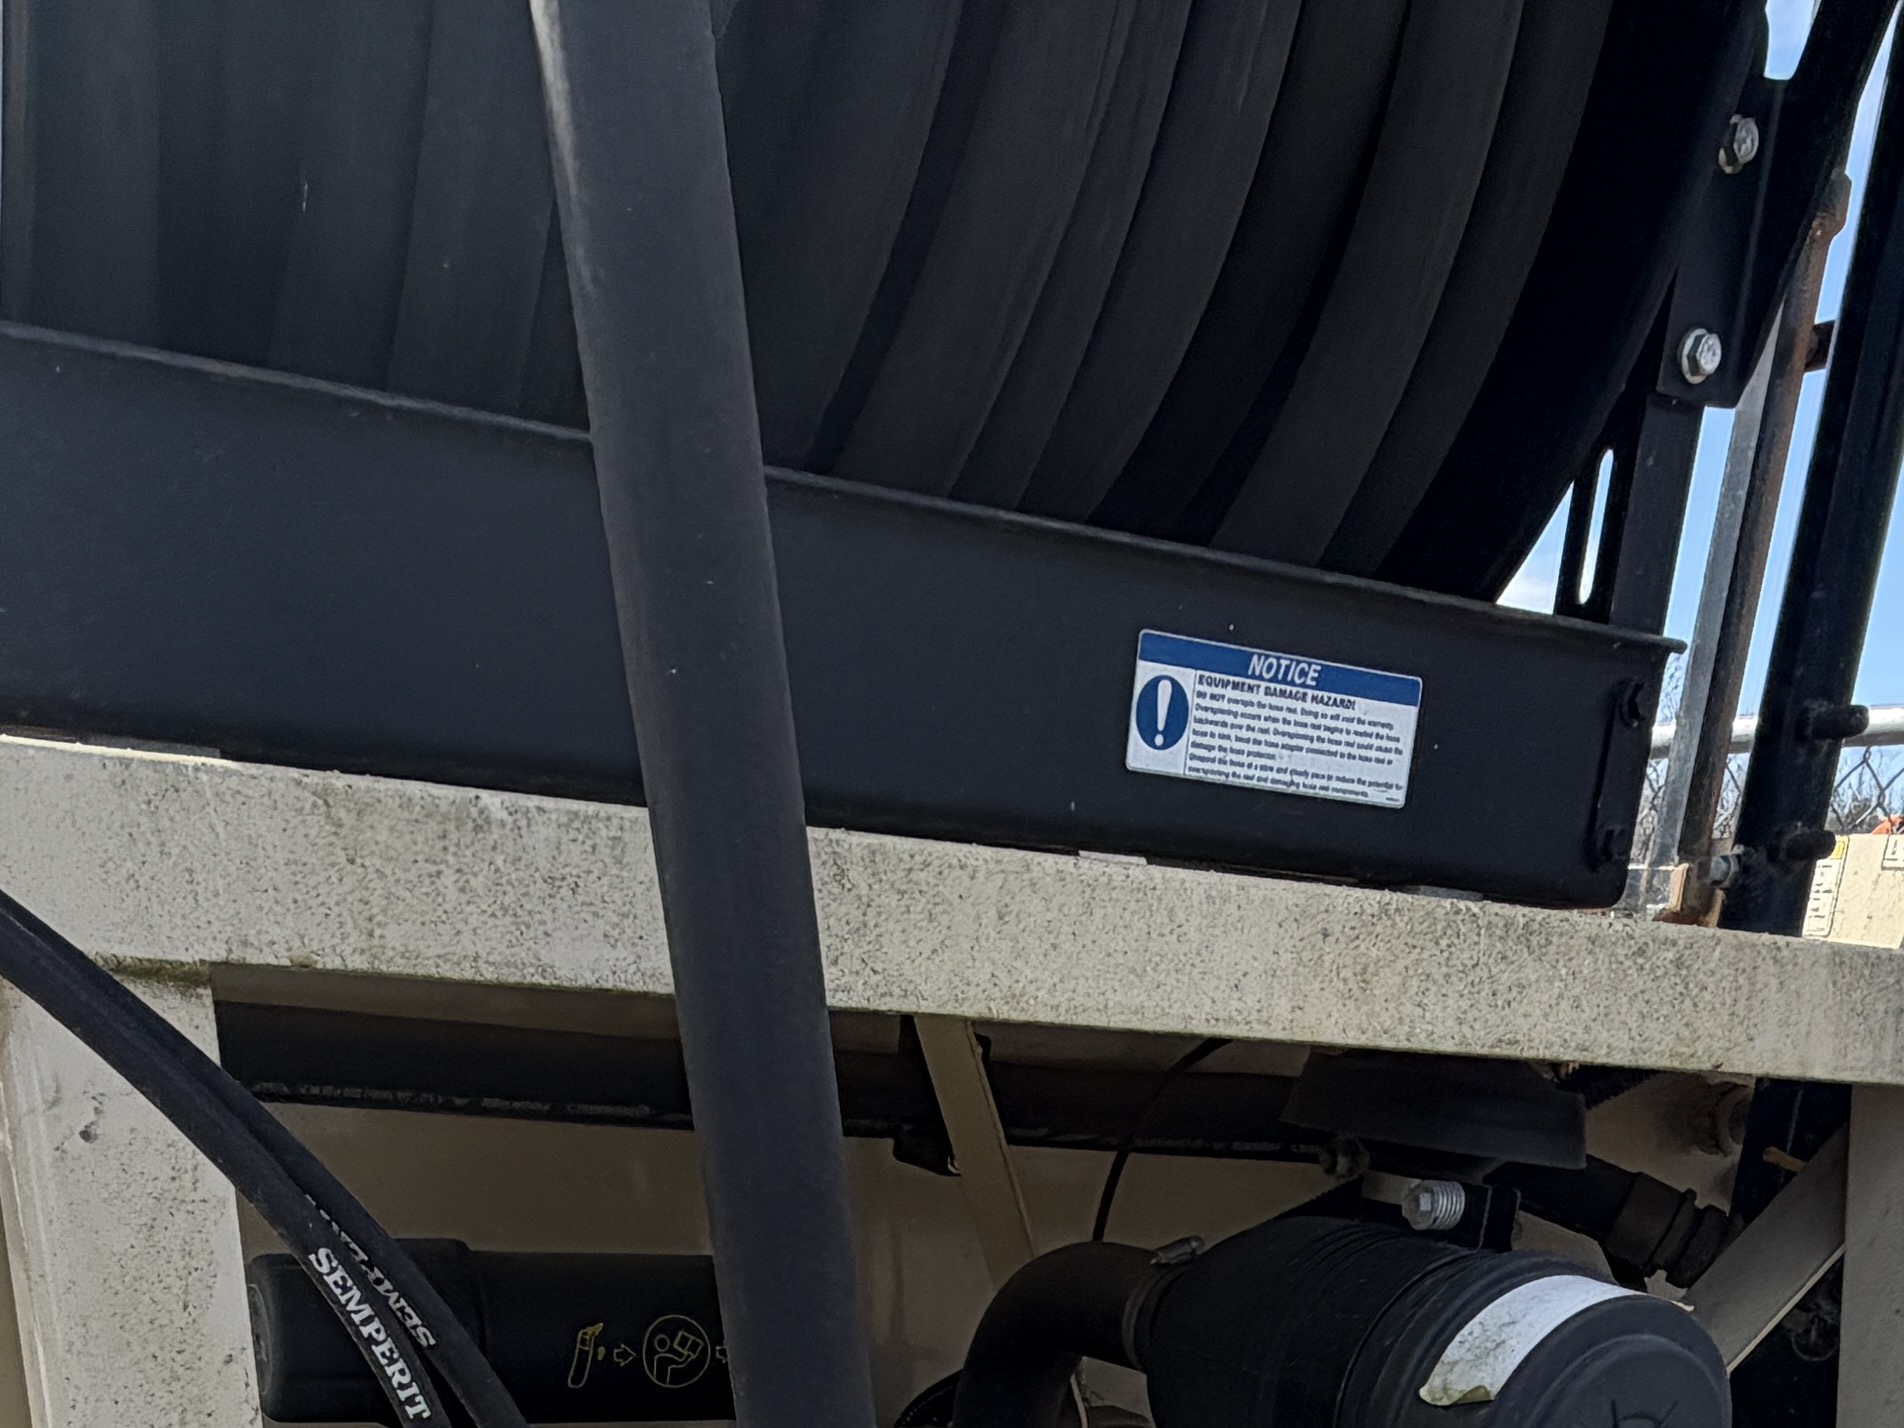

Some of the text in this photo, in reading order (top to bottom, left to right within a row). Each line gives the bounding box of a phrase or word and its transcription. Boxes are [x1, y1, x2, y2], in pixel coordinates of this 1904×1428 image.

[1247, 653, 1322, 687] NOTICE
[1197, 672, 1356, 711] EQUIPMENT DAMAGE HAZARD!
[308, 1246, 433, 1422] SEMPERIT
